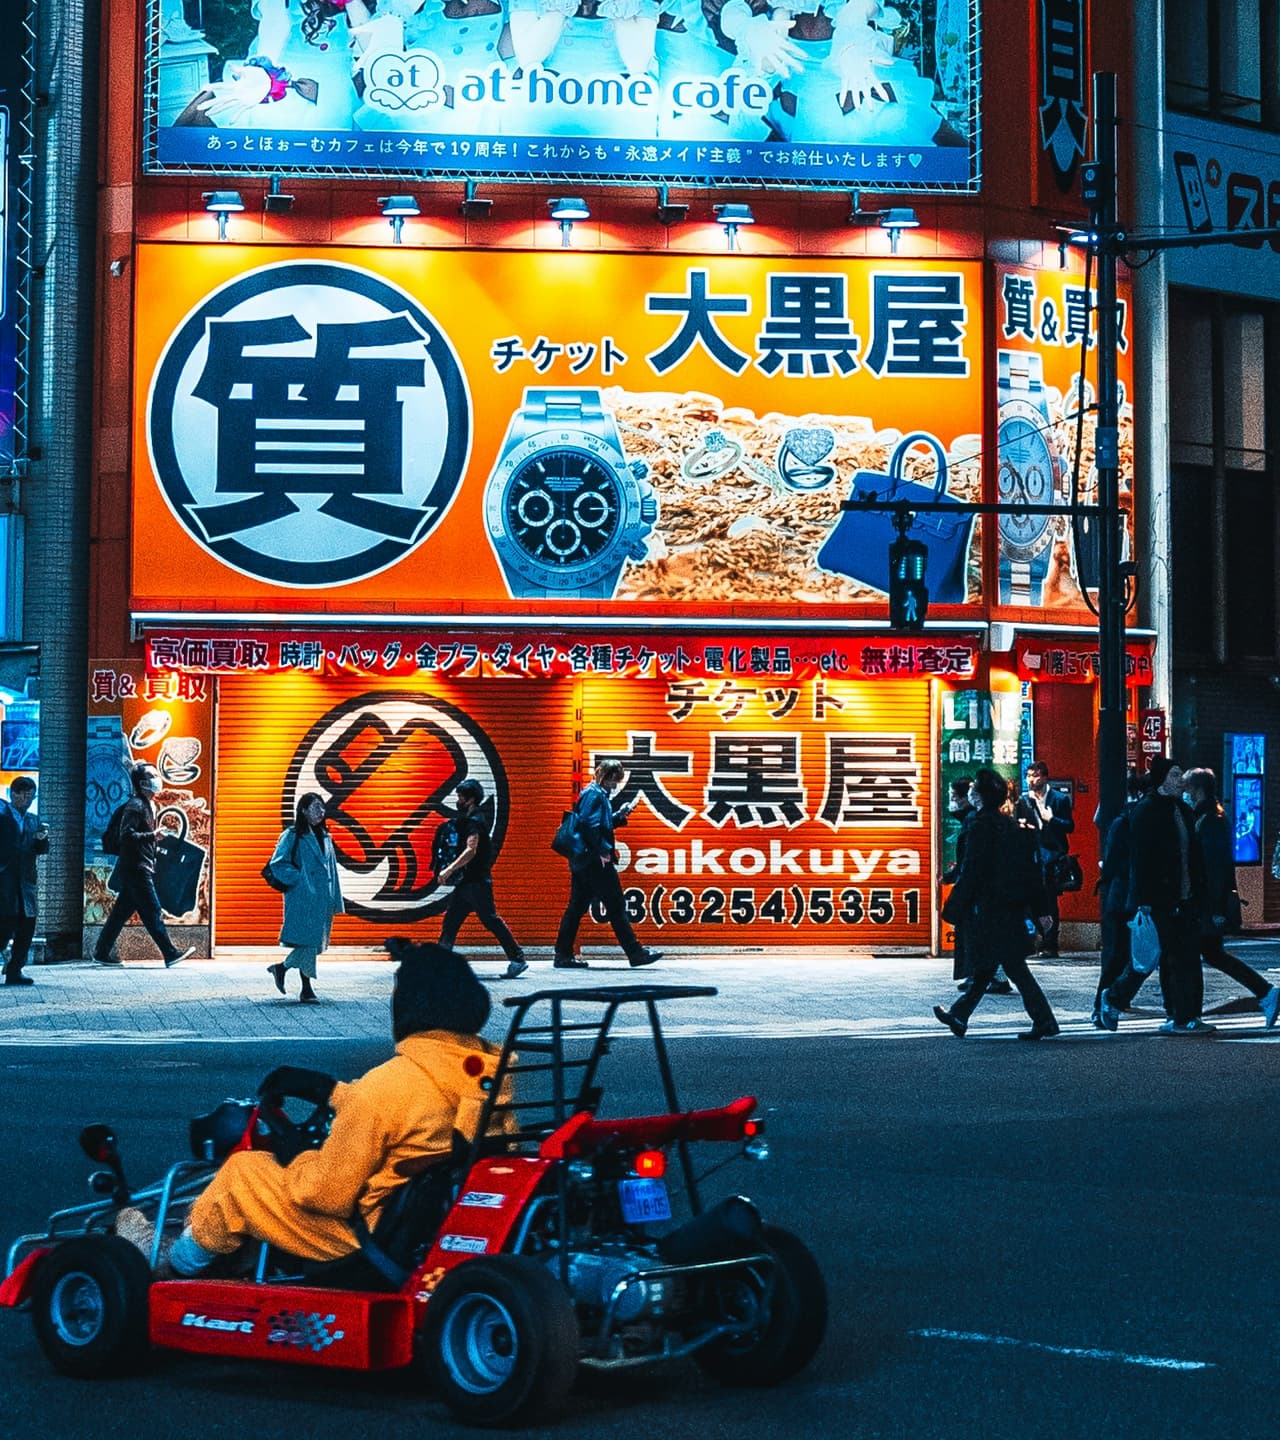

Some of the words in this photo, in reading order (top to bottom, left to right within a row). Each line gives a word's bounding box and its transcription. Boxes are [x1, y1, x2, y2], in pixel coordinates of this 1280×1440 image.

[461, 66, 654, 108] at-home
[671, 72, 773, 113] cafe
[492, 335, 627, 374] チケット
[649, 271, 968, 377] 大黒屋
[186, 310, 432, 544] 質
[149, 637, 269, 669] 高価買取
[859, 644, 975, 677] 無料査定
[666, 680, 843, 723] チケット
[596, 732, 921, 832] 大黒屋
[181, 1312, 255, 1334] Kart
